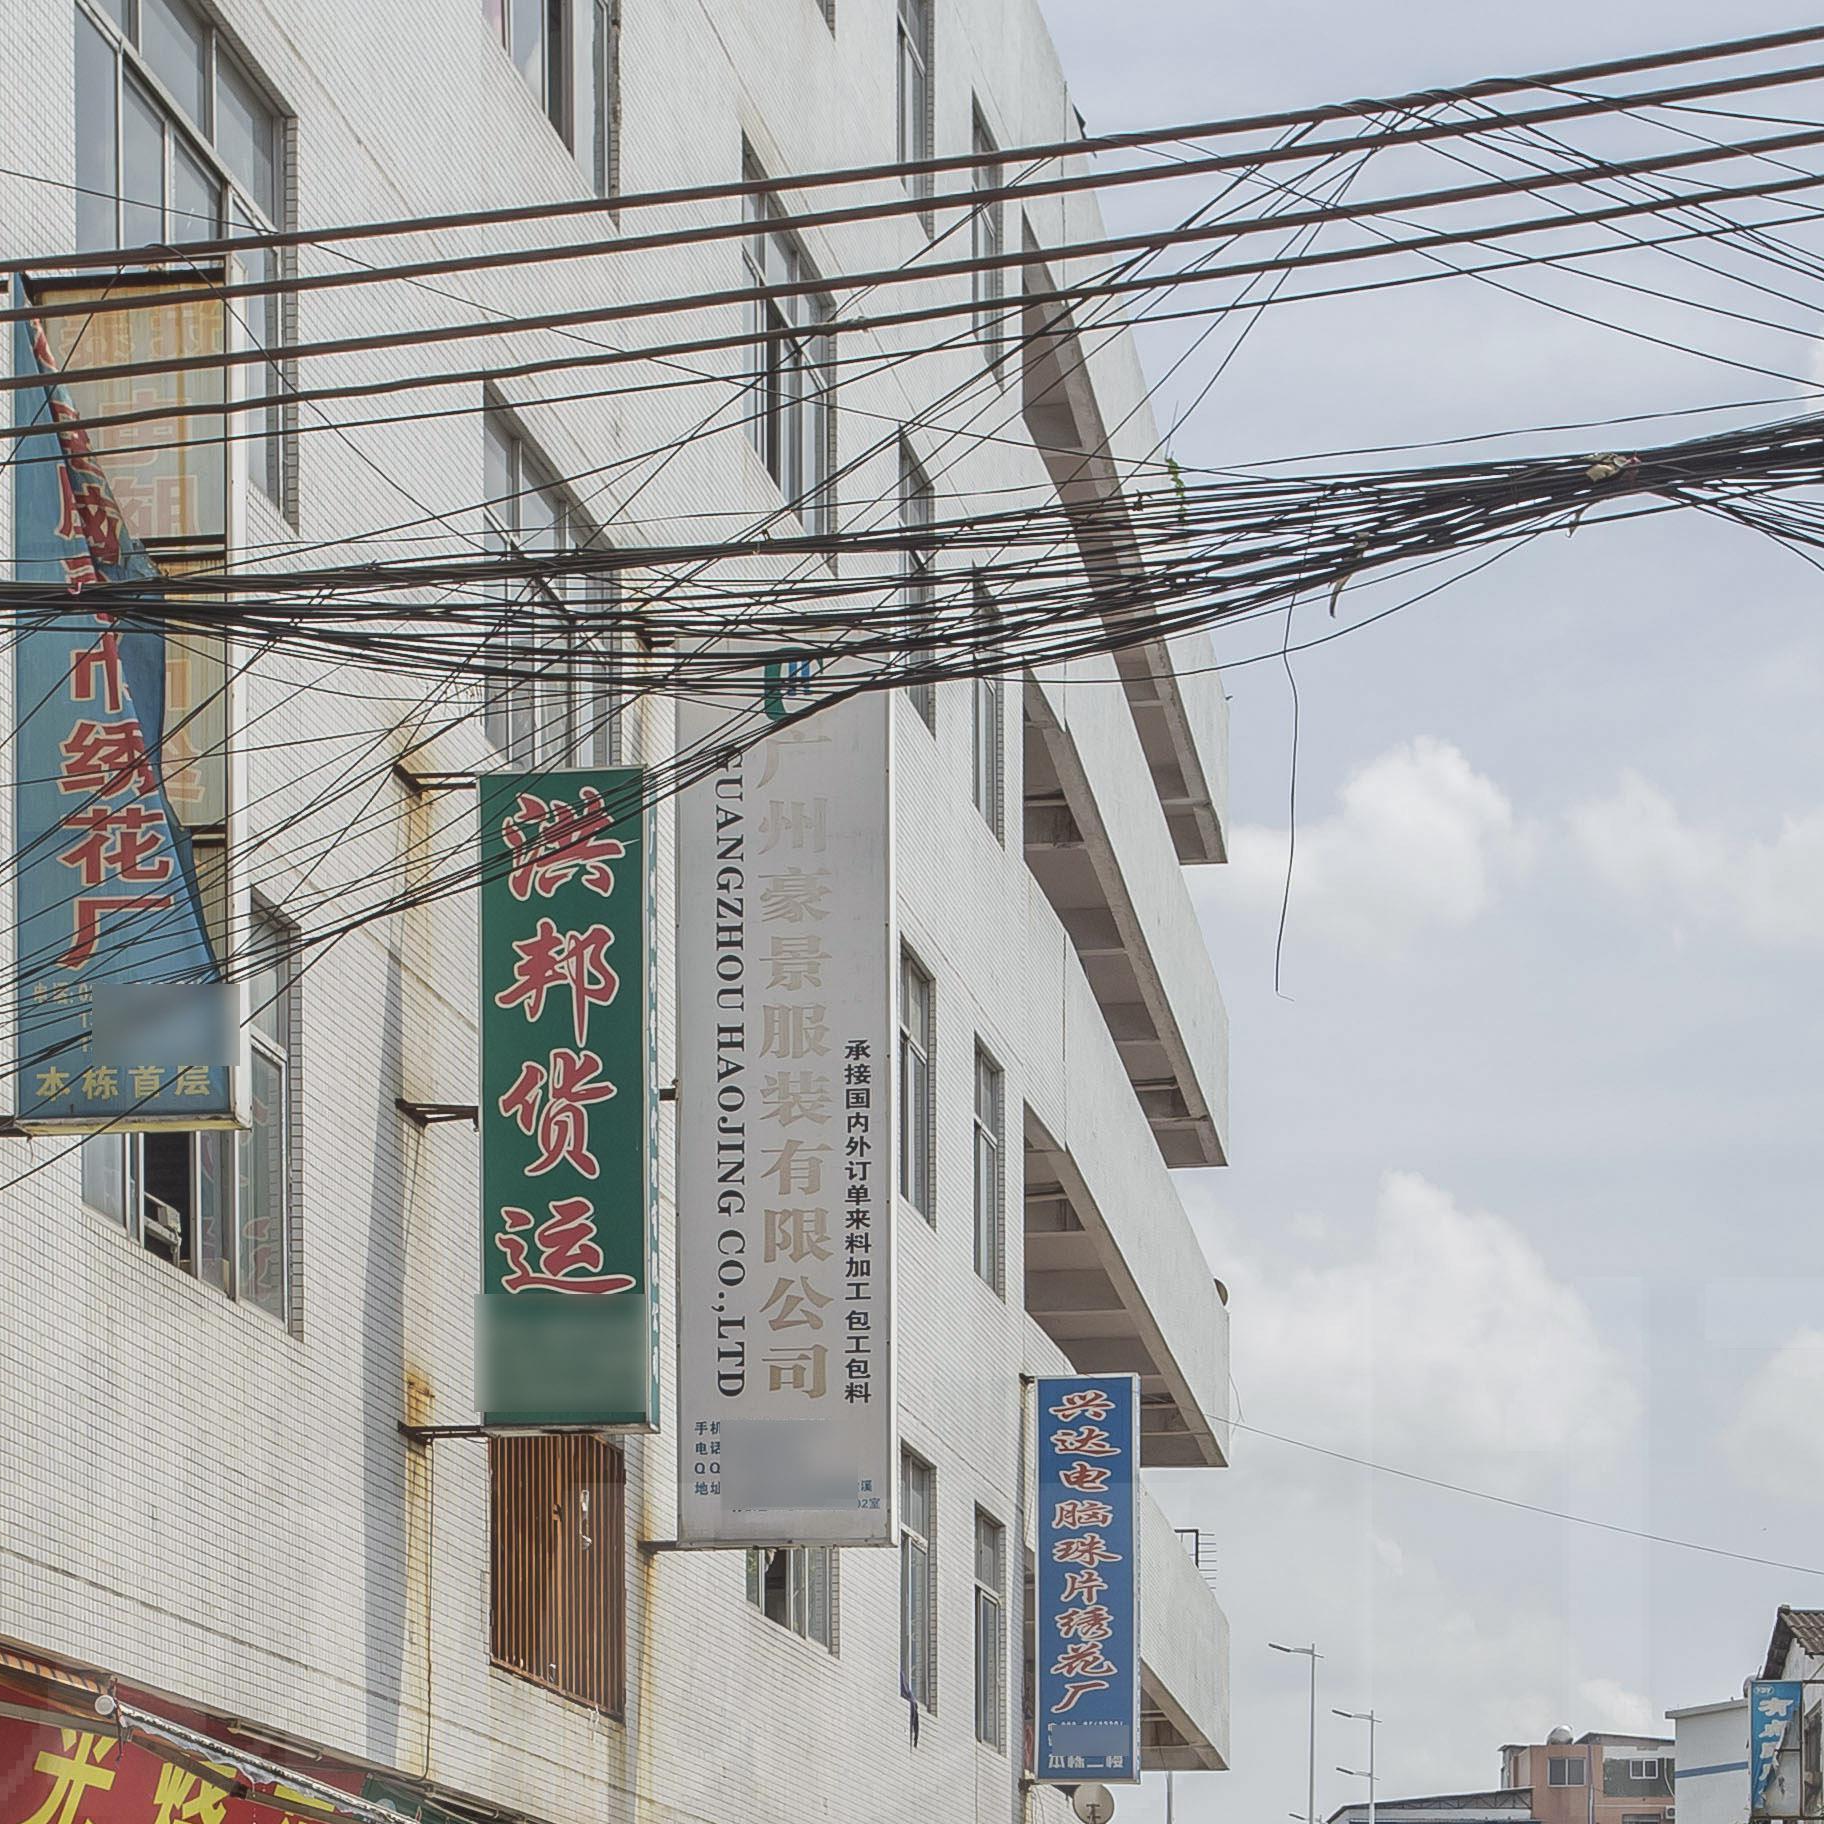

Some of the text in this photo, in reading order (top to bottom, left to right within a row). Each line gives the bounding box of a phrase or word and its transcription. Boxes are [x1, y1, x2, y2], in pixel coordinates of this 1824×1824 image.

[494, 786, 638, 1296] 洪邦货运
[712, 745, 746, 1014] GUANGZHOU
[35, 1063, 211, 1101] 本栋首层
[714, 1022, 746, 1217] HAOJING
[756, 726, 832, 1402] 广州豪景服装有限公司
[844, 1038, 872, 1404] 承接国内外订单来料加工 包工包料
[1048, 1389, 1122, 1714] 兴达电脑珠片绣花厂
